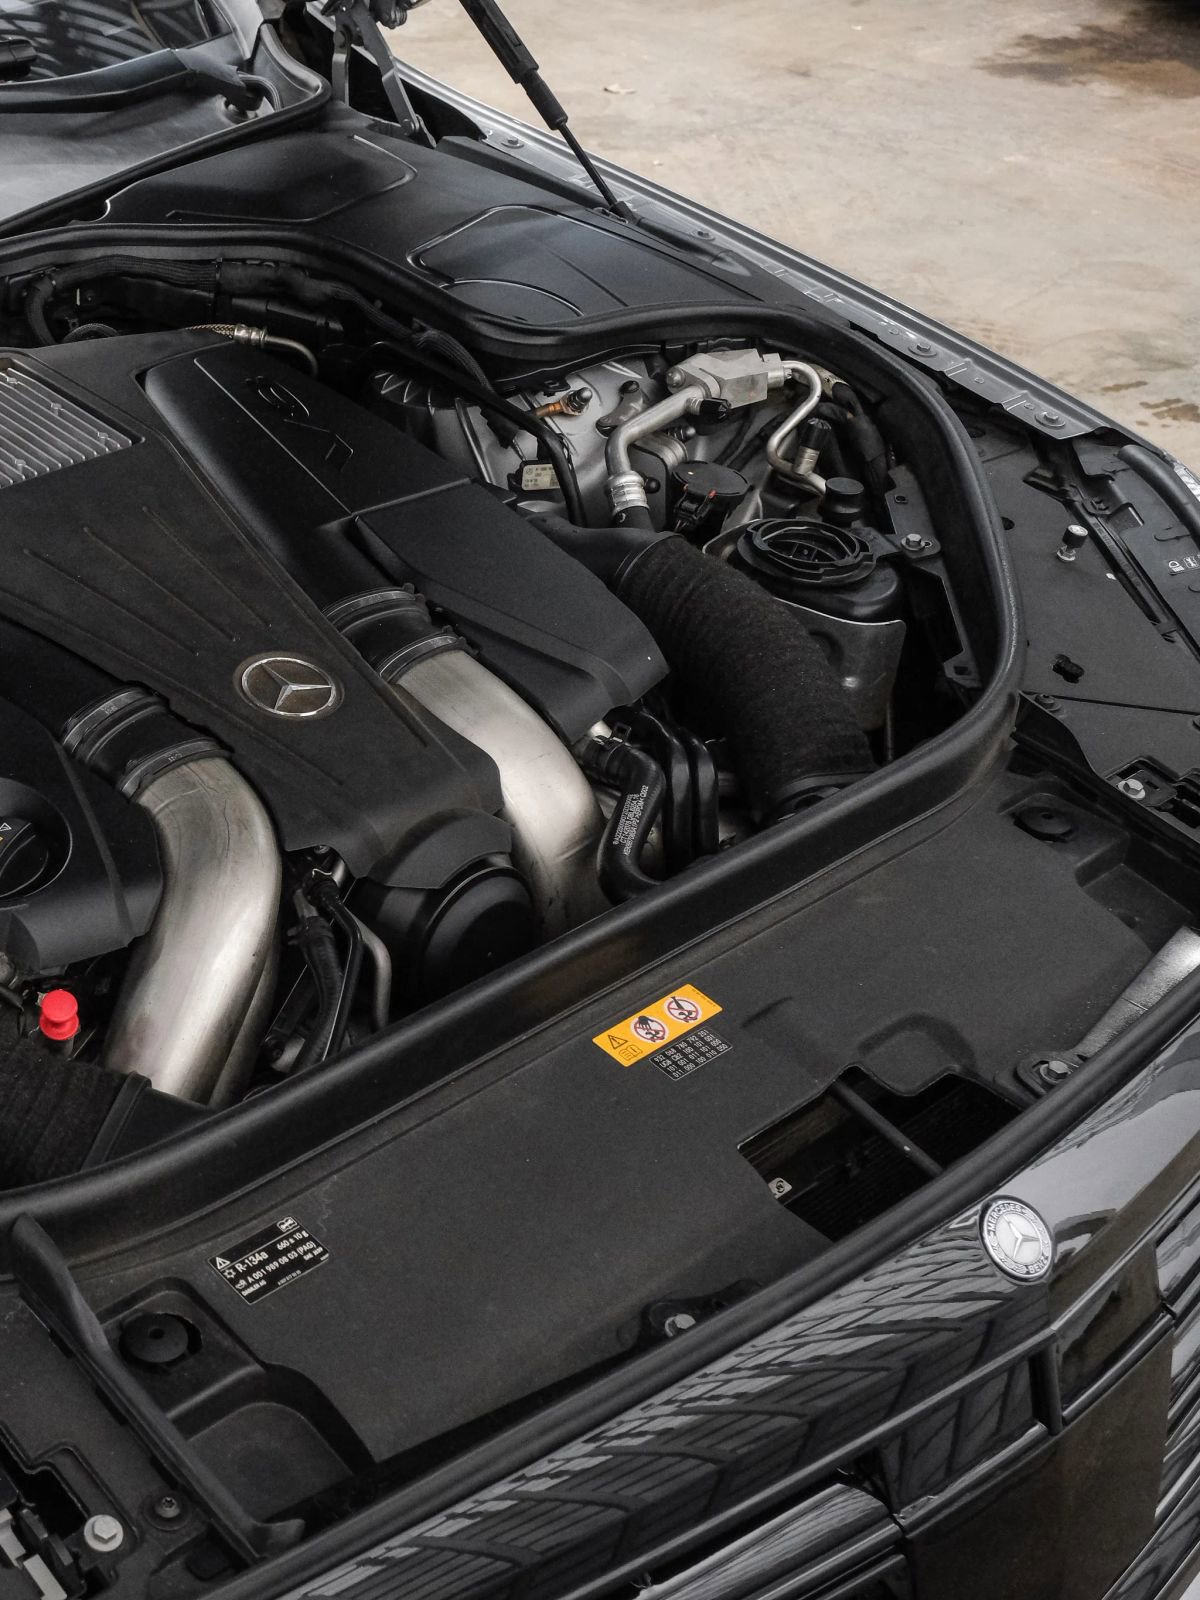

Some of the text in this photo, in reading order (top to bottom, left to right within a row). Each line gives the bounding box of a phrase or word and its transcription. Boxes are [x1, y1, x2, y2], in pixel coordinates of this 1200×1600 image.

[235, 1251, 269, 1272] R-134a
[276, 1239, 290, 1250] 660
[293, 1232, 303, 1241] 10
[987, 1202, 1049, 1274] MERCEDES BENZ
[252, 1268, 267, 1280] 001
[265, 1261, 280, 1272] 989
[287, 1251, 298, 1260] 03
[296, 1241, 317, 1255] (PAG)
